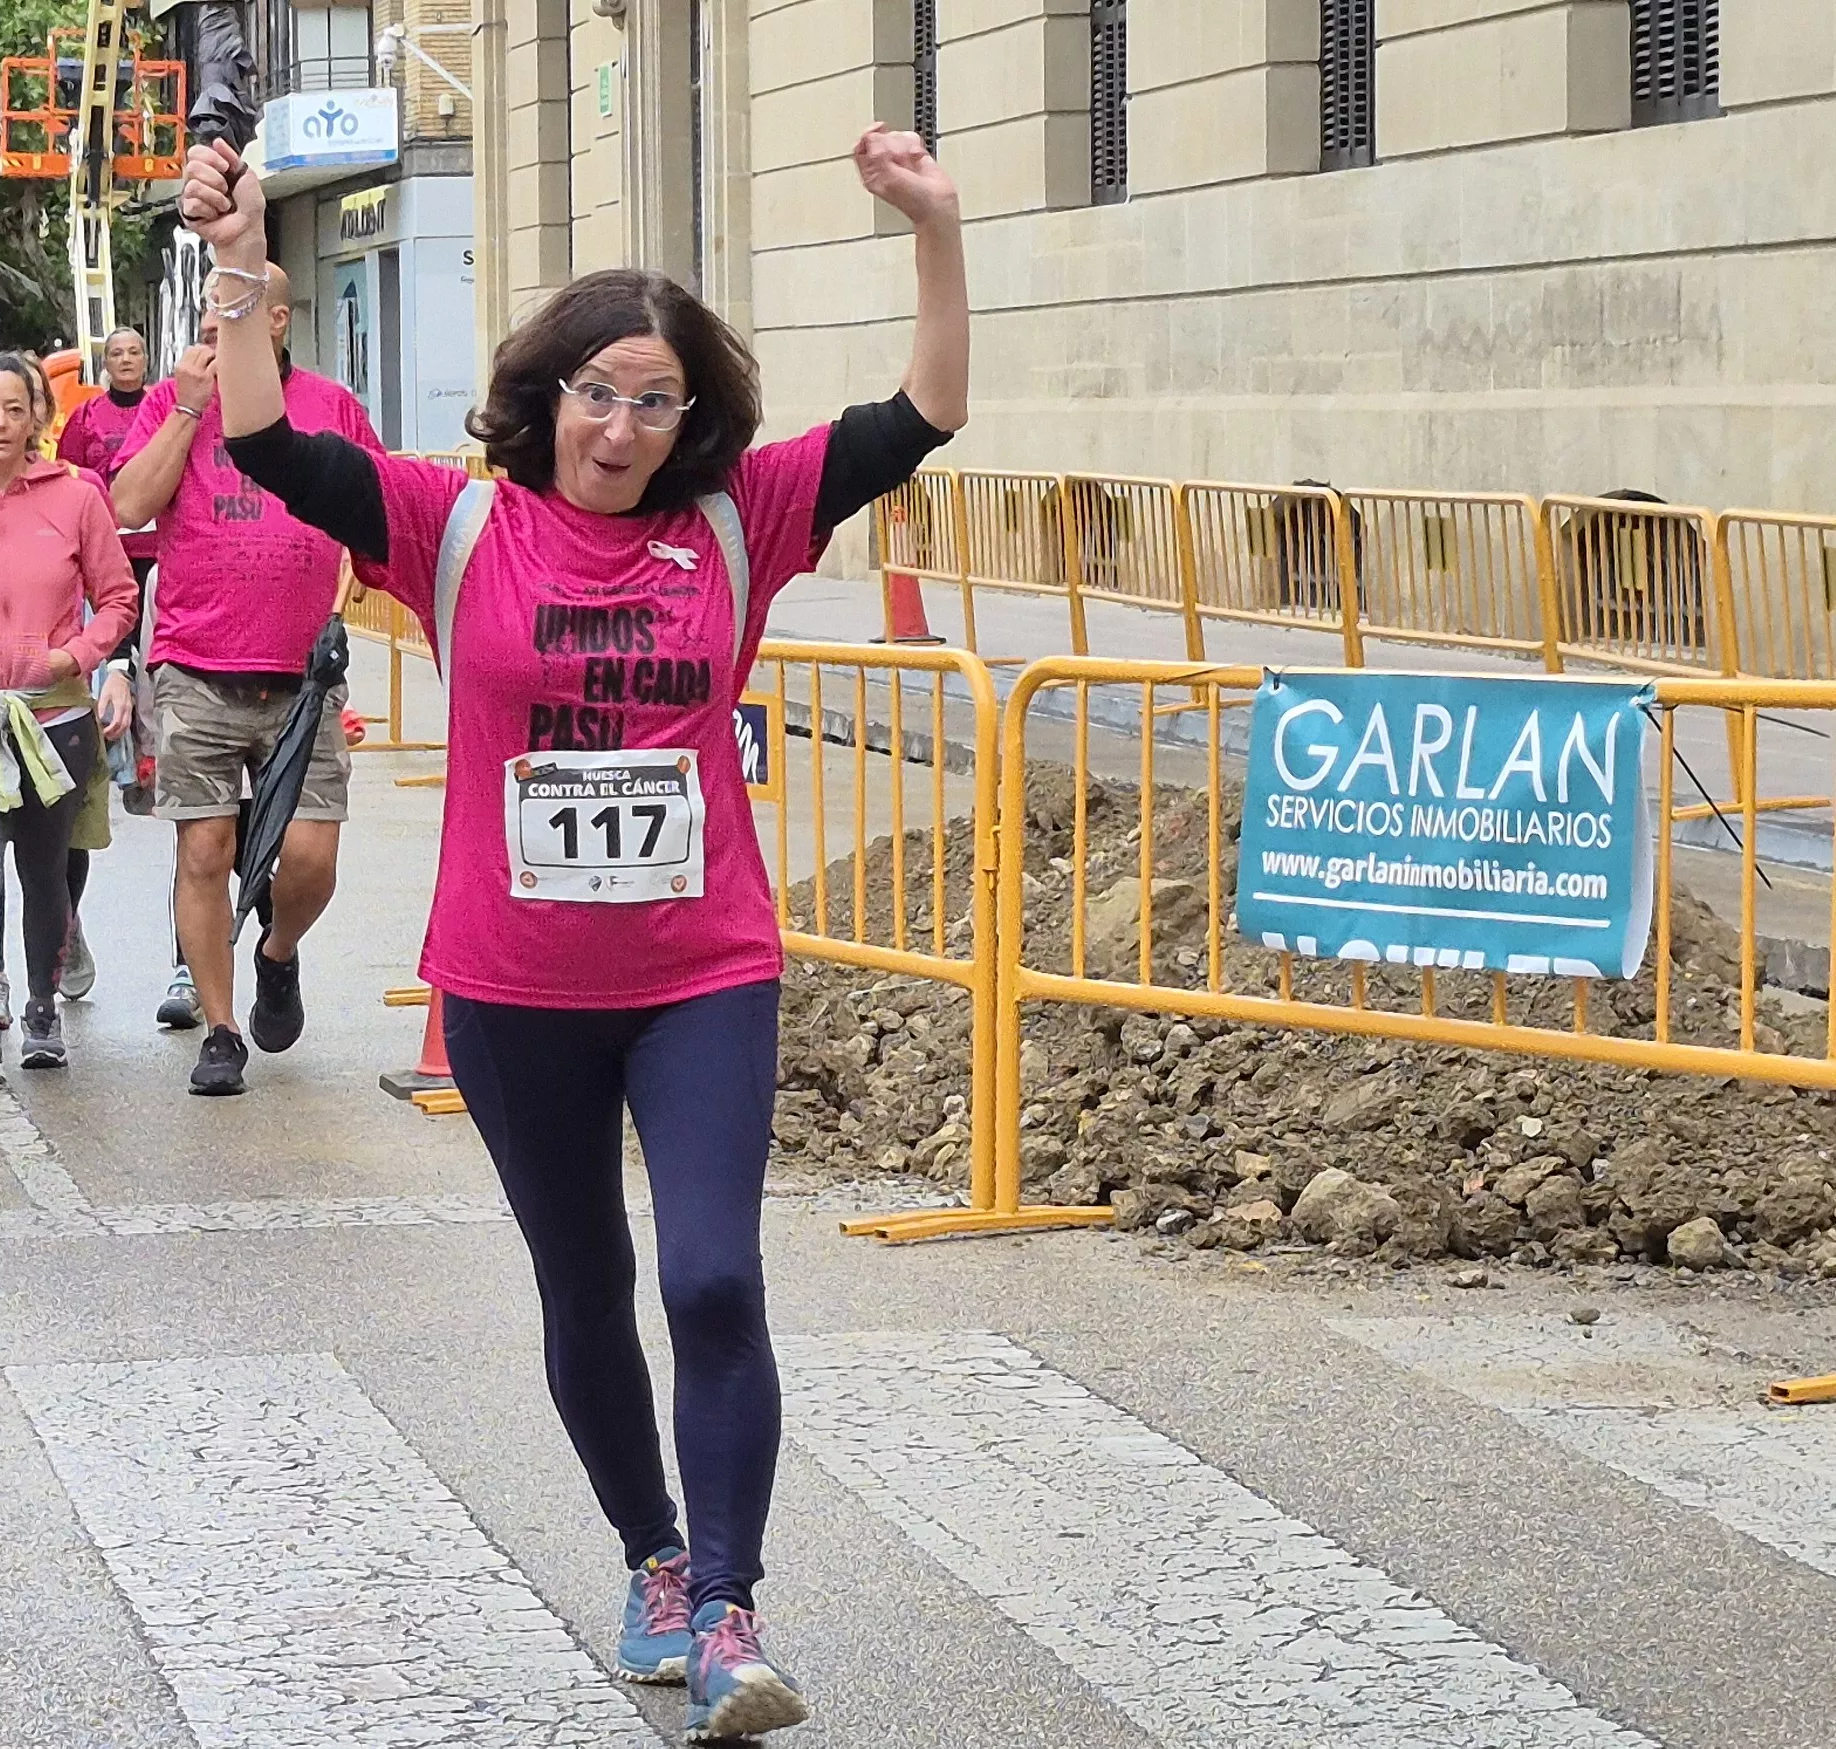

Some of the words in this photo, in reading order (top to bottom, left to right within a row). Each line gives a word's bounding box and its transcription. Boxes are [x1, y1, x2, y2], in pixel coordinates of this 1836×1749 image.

[533, 604, 656, 654] UNIDOS
[583, 656, 626, 702] EN
[632, 657, 711, 705] CADA
[582, 769, 632, 782] HUESCA
[1273, 698, 1622, 806] GARLAN
[527, 782, 596, 797] CONTRA
[599, 782, 619, 796] EL
[621, 777, 681, 796] CÁNCER
[548, 804, 667, 859] 117
[1266, 793, 1403, 838] SERVICIOS
[1410, 804, 1613, 850] INMOBILIARIOS
[1261, 850, 1608, 901] www.garlaninmobiliaria.com
